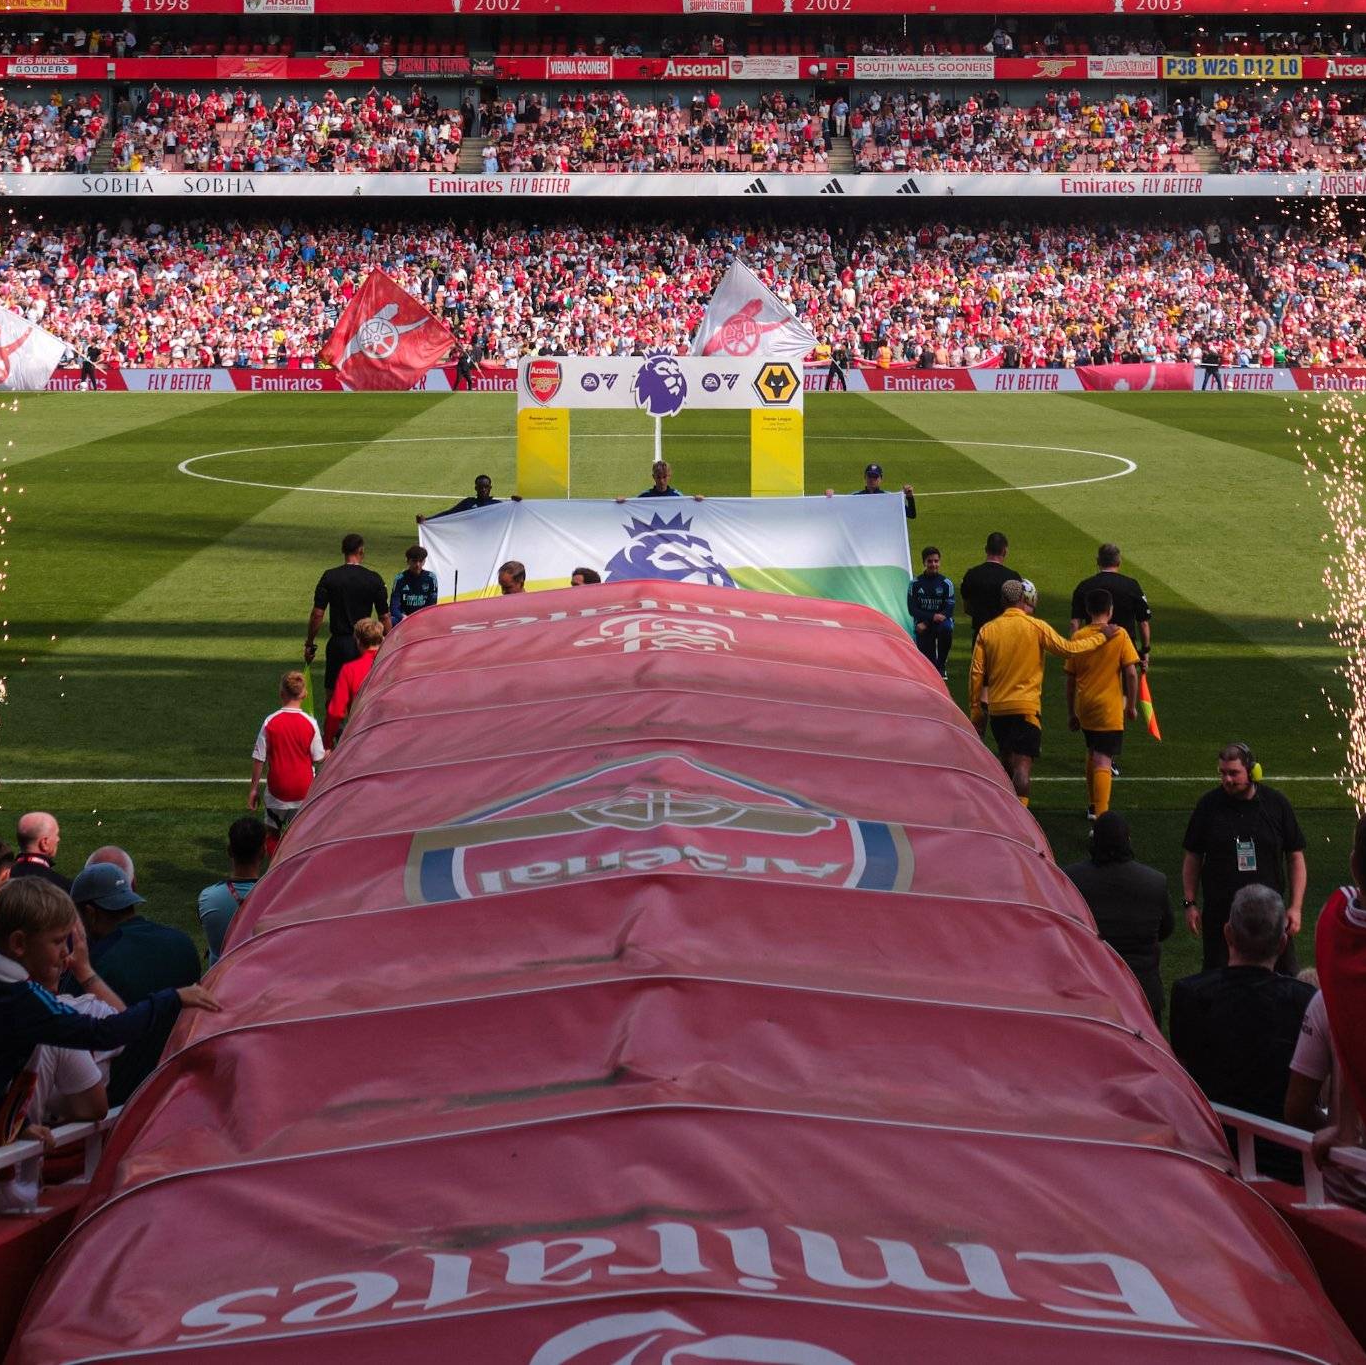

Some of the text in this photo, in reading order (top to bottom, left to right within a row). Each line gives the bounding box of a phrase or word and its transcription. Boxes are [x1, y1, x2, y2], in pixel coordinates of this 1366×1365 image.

[690, 1, 745, 11] SUPPORTERS CLUB
[14, 65, 69, 74] GOONERS
[551, 61, 609, 75] VIENNA GOONERS
[665, 60, 727, 77] Arsenal
[857, 62, 992, 72] SOUTH WALES GOONERS
[1106, 58, 1155, 71] Arsenal
[1166, 59, 1197, 76] P38
[1203, 59, 1238, 76] W26
[1244, 59, 1275, 76] D12
[82, 177, 154, 193] SOBHA
[184, 177, 256, 193] SOBHA
[428, 177, 570, 194] Emirates FLY BETTER
[1060, 177, 1202, 194] Emirates FLY BETTER
[530, 366, 558, 375] Arsenal
[148, 374, 211, 390] FLY BETTER
[251, 375, 323, 391] Emirates
[884, 375, 955, 391] Emirates
[996, 374, 1058, 390] FLY BETTER
[1233, 374, 1273, 390] BETTER
[480, 845, 846, 894] Arsenal
[180, 1222, 1201, 1340] Emirates
